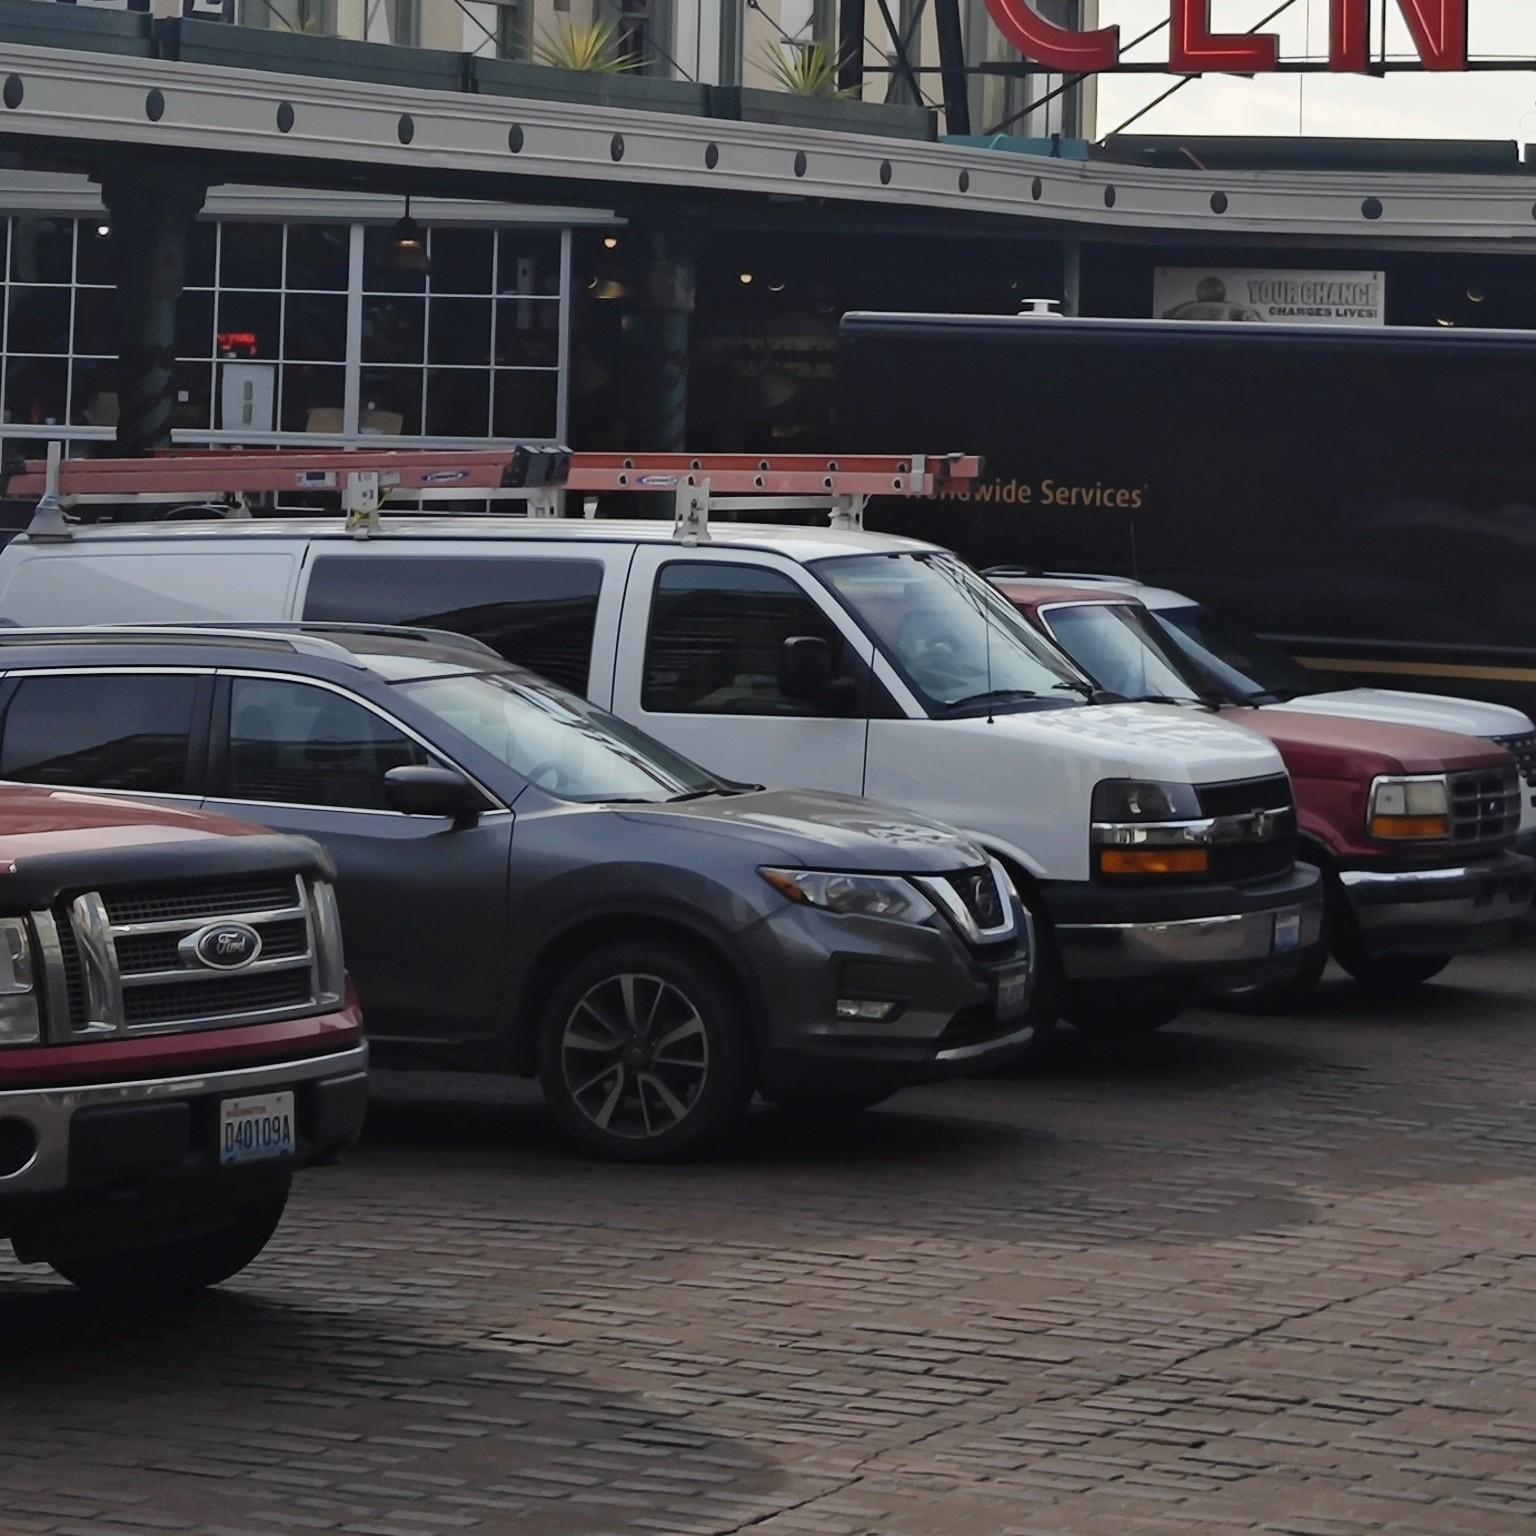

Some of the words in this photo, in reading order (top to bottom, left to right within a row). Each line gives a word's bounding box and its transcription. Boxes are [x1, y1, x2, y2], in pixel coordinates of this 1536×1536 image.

[1247, 279, 1298, 305] YOUR
[1301, 281, 1378, 307] CHANGE
[1268, 306, 1332, 317] CHANGES
[1041, 479, 1142, 509] Services
[216, 932, 246, 955] Ford
